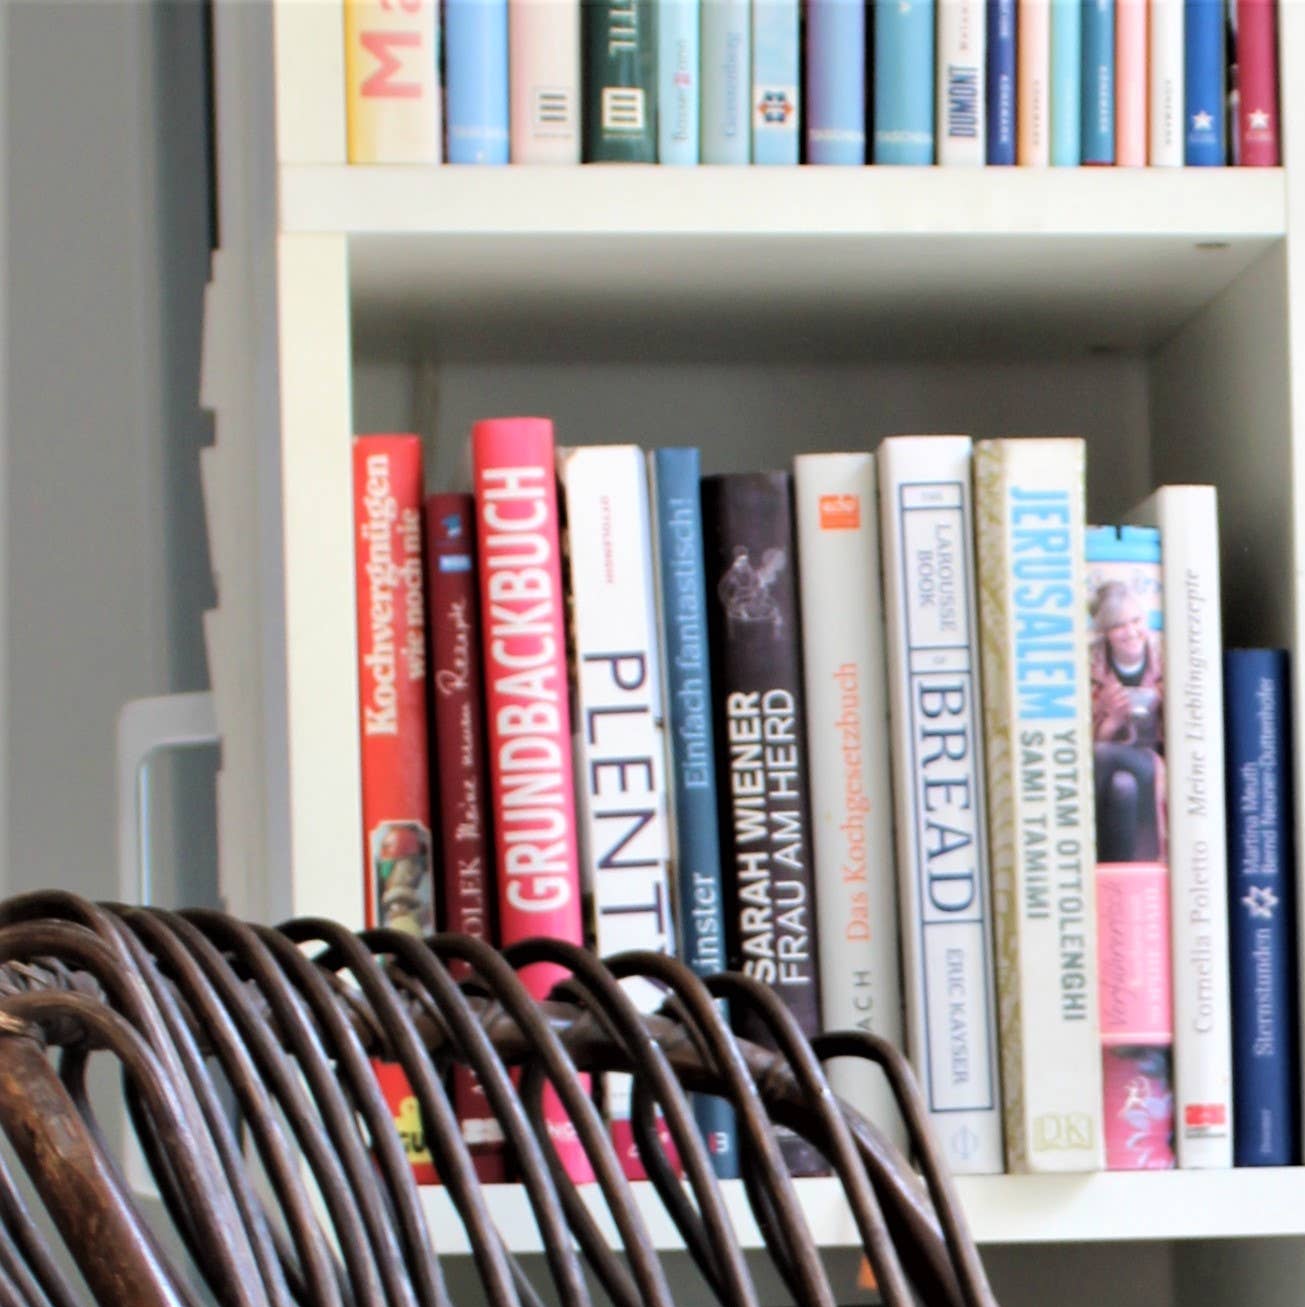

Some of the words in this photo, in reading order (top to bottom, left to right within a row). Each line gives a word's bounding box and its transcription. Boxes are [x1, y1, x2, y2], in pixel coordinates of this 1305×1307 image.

[948, 65, 979, 138] DUMONT
[396, 508, 420, 553] nie
[917, 549, 935, 608] BOOK
[935, 522, 958, 631] LAROUSSE
[362, 454, 398, 736] Kochvergnügen
[400, 558, 424, 626] noch
[667, 497, 700, 670] fantastisch!
[1010, 486, 1077, 720] JERUSALEM
[403, 630, 425, 680] wie
[482, 467, 571, 912] GRUNDBACKBUCH
[1182, 568, 1209, 743] Lieblingsrezepte
[677, 678, 709, 789] Einfach
[727, 691, 767, 841] WIENER
[762, 689, 801, 798] HERD
[833, 662, 870, 884] Kochgesetzbuch
[1020, 730, 1048, 802] SAMI
[1052, 729, 1079, 826] YOTAM
[1184, 751, 1207, 817] Meine
[772, 810, 803, 868] AM
[917, 682, 976, 913] BREAD
[737, 852, 777, 983] SARAH
[844, 891, 871, 942] Das
[1023, 815, 1050, 919] TAMIMI
[774, 880, 810, 985] FRAU
[945, 948, 965, 1000] ERIC
[1055, 839, 1087, 1022] OTTOLENGHI
[1190, 935, 1216, 1035] Cornelia
[1251, 927, 1274, 1056] Sternstunden
[948, 1002, 970, 1085] KAYSER
